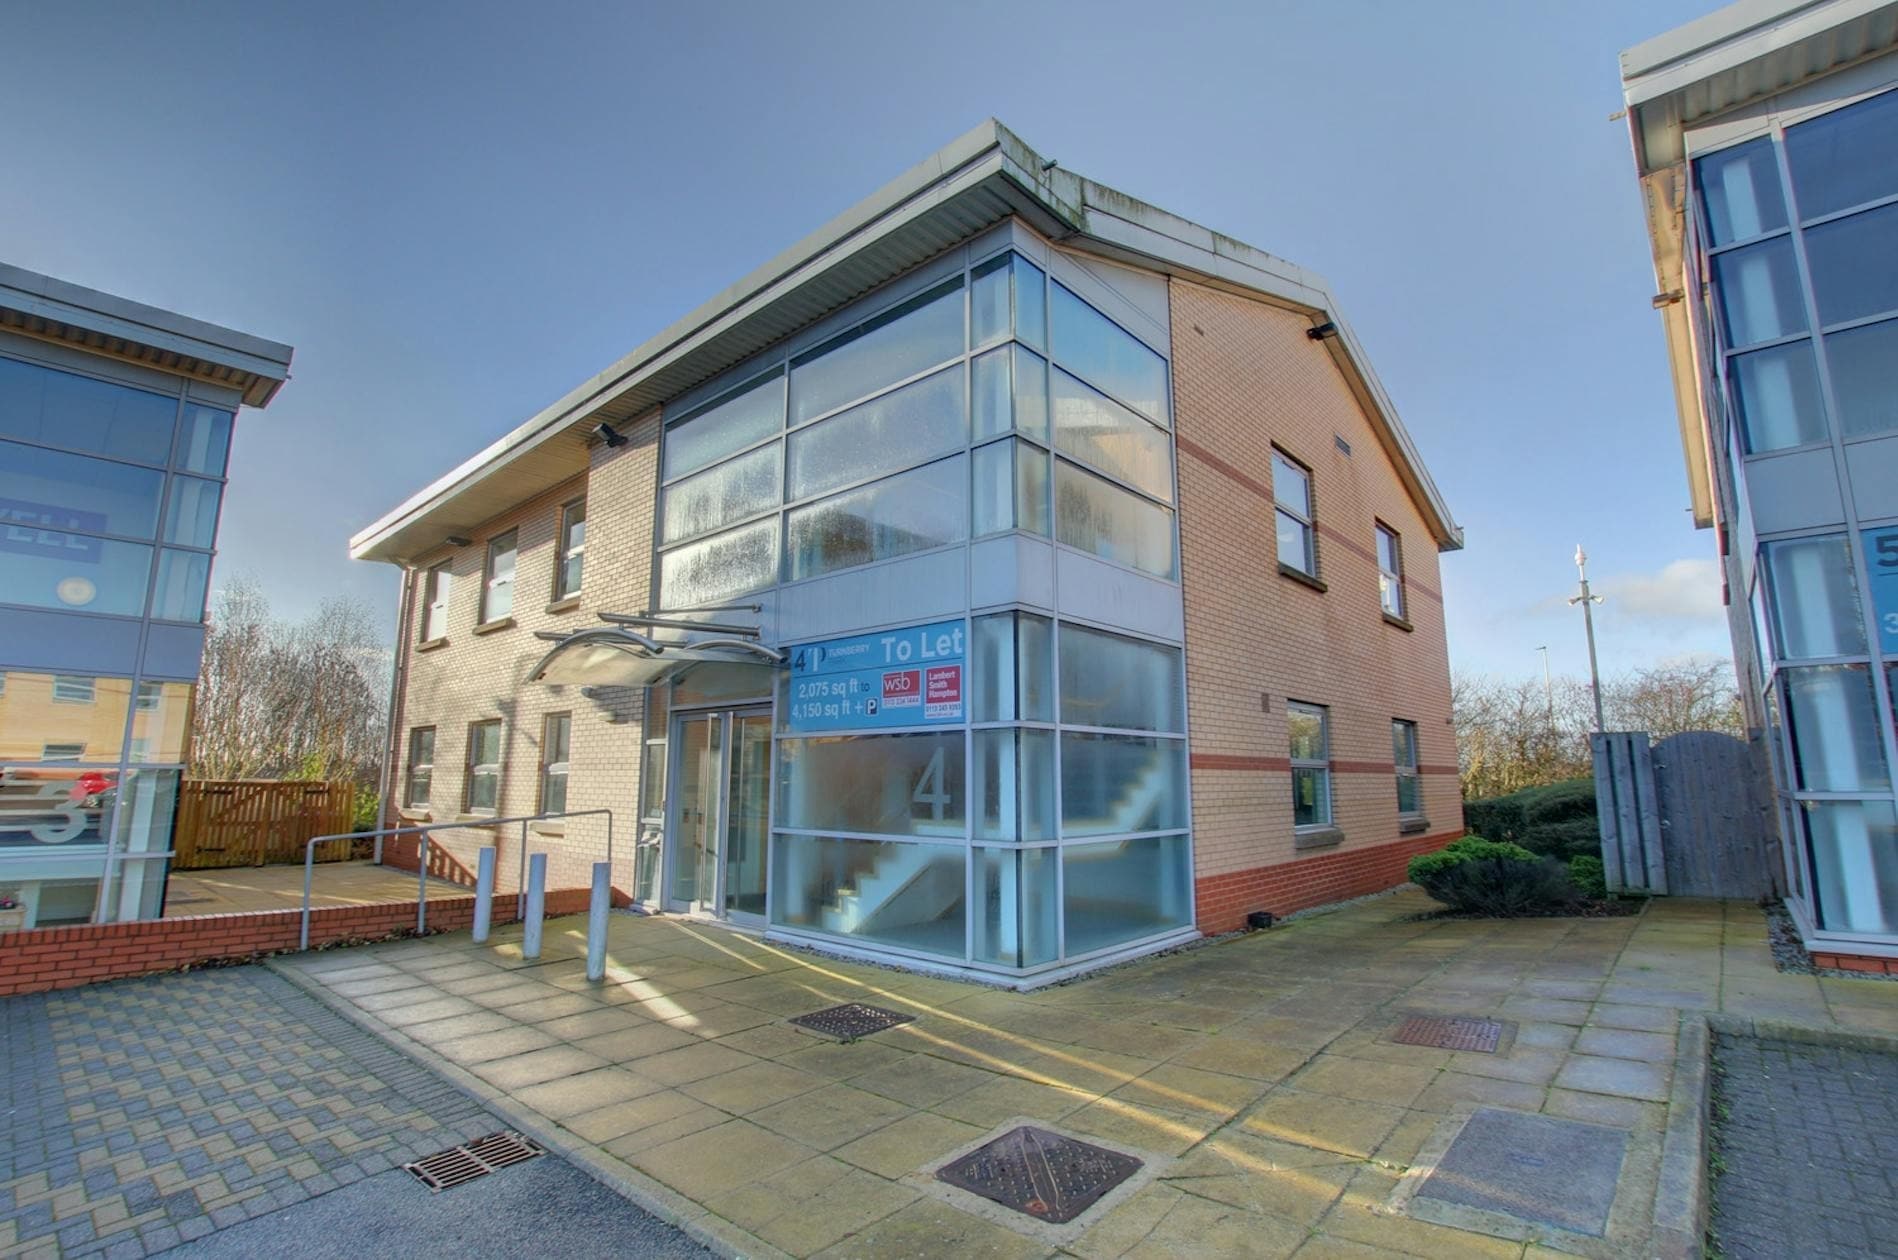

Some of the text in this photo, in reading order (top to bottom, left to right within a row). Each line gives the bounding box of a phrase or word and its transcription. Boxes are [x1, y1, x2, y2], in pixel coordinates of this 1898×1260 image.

[881, 628, 963, 663] To Let
[884, 672, 911, 691] wsb
[928, 680, 948, 689] Smith
[929, 671, 956, 680] Lambert
[799, 682, 829, 699] 2,075
[831, 682, 846, 698] sq
[849, 678, 858, 693] ft
[792, 702, 822, 719] 4,150
[824, 703, 839, 719] sq
[842, 699, 850, 715] ft
[913, 746, 951, 820] 4
[30, 781, 88, 843] 3
